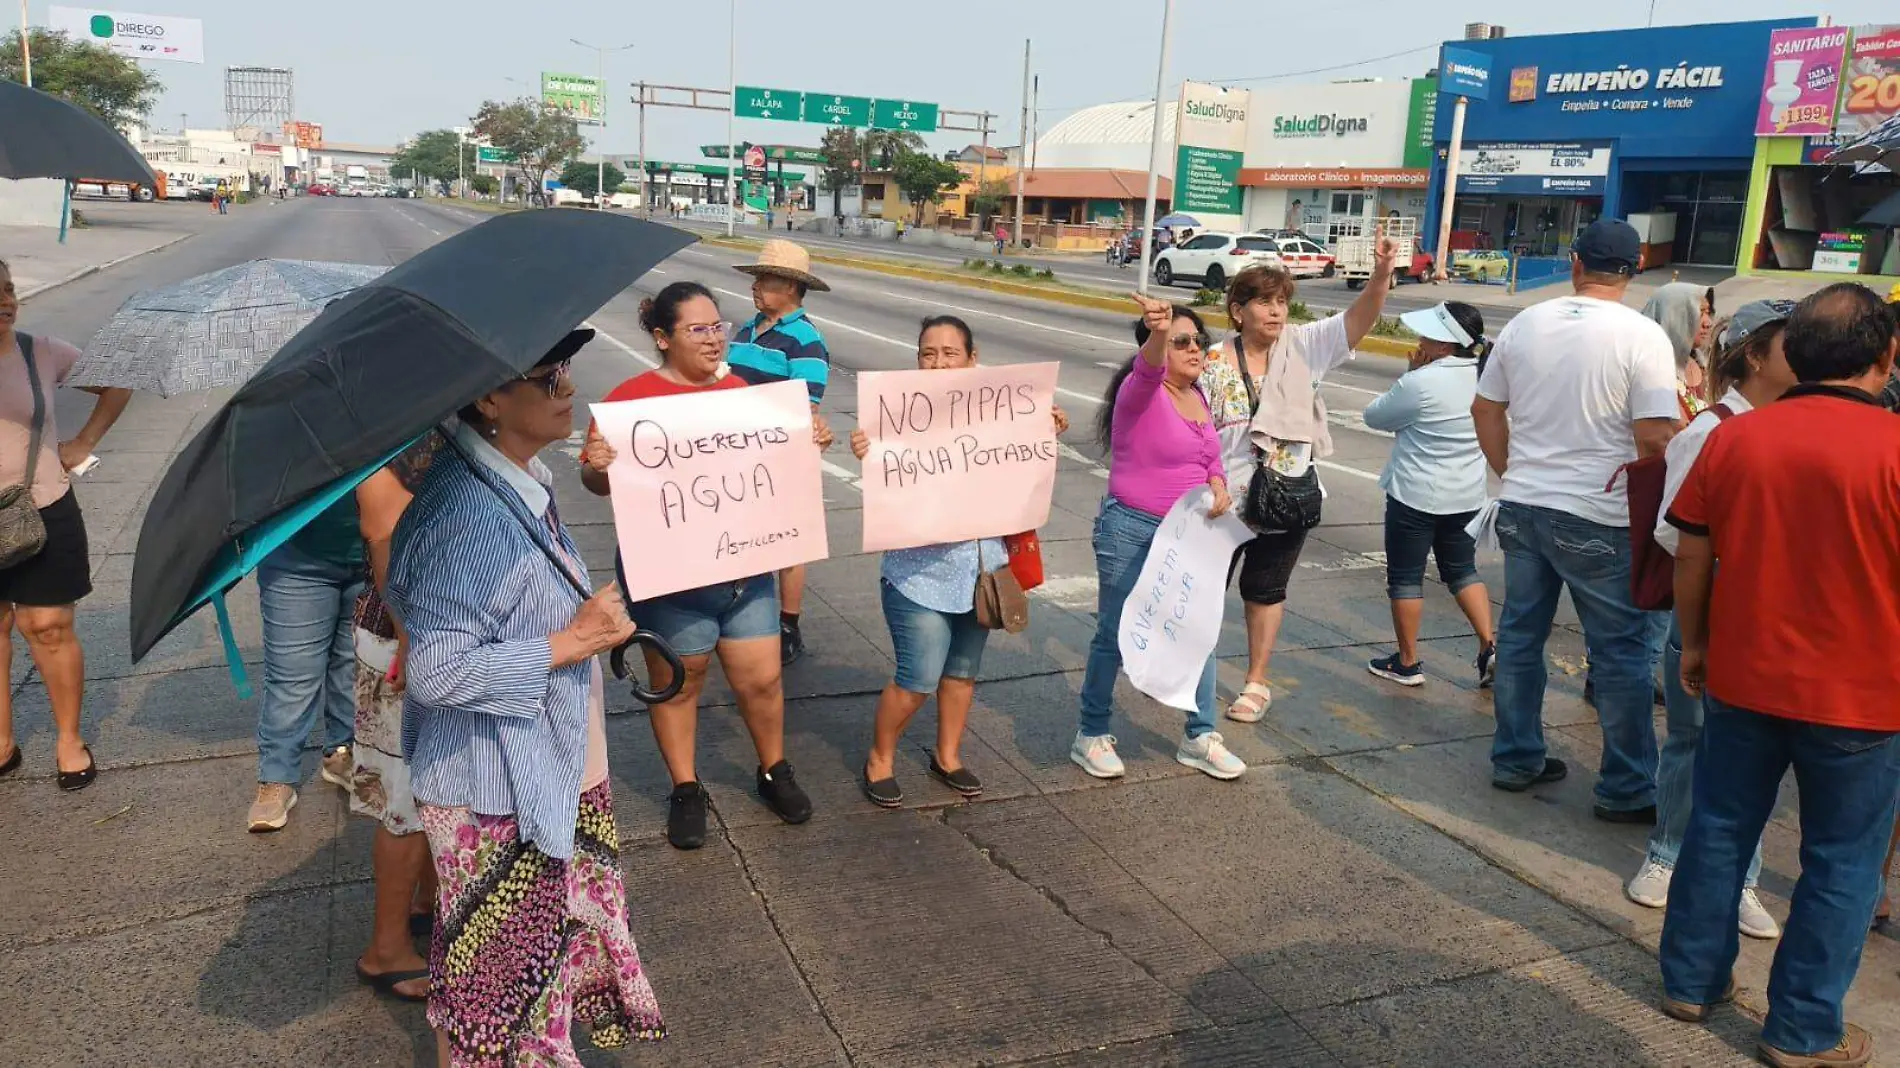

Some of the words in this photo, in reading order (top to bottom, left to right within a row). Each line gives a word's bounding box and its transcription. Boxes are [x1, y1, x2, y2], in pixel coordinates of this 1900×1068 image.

[116, 22, 165, 36] DIREGO
[1774, 33, 1844, 56] SANITARIO
[1546, 64, 1649, 93] EMPEÑO
[1655, 60, 1724, 90] FÁCIL
[751, 98, 783, 109] XALAPA
[823, 104, 851, 115] CARDEL
[1186, 100, 1246, 122] SaludDigna
[1611, 99, 1649, 112] Compra
[1663, 97, 1694, 108] Vende
[1273, 113, 1369, 136] SaludDigna
[1264, 172, 1316, 182] Laboratorio
[1319, 171, 1350, 182] Clínico
[1360, 172, 1425, 185] Imagenología
[879, 392, 933, 443] NO
[947, 384, 1036, 430] PIPAS
[632, 419, 789, 469] QUEREMOS
[883, 446, 952, 488] AGUA
[661, 463, 775, 529] AGUA
[1163, 571, 1196, 644] AGUA
